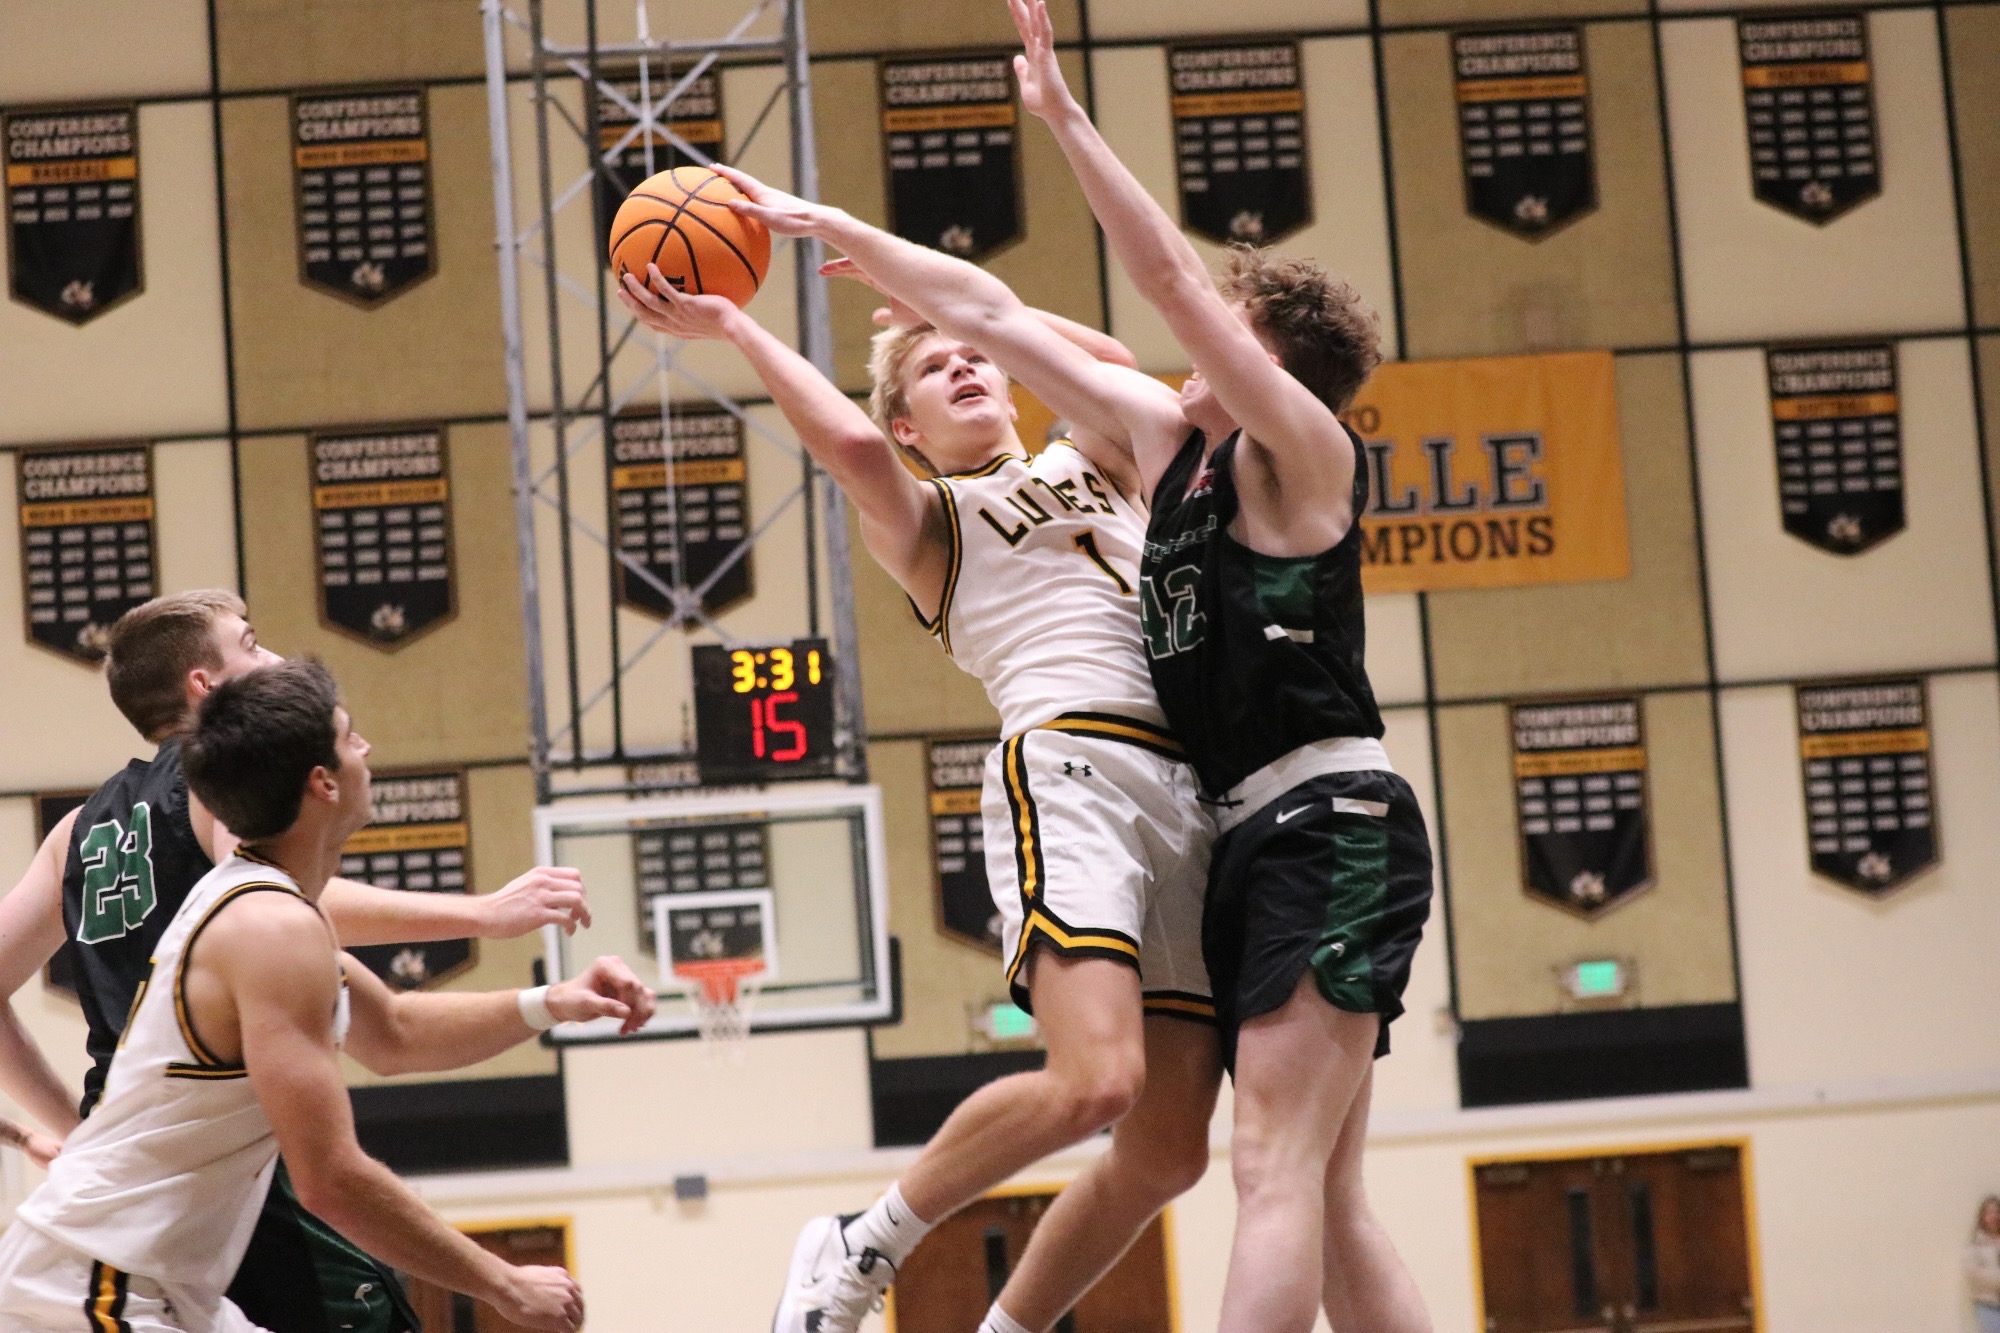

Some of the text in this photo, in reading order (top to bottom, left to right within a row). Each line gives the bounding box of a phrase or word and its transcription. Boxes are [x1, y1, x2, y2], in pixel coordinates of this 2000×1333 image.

[978, 471, 1118, 547] LUTES
[1366, 431, 1546, 519] LLE
[1071, 527, 1134, 597] 1
[1359, 515, 1557, 566] MPIONS
[731, 648, 822, 693] 3:31
[751, 691, 808, 762] 15
[76, 801, 158, 945] 23
